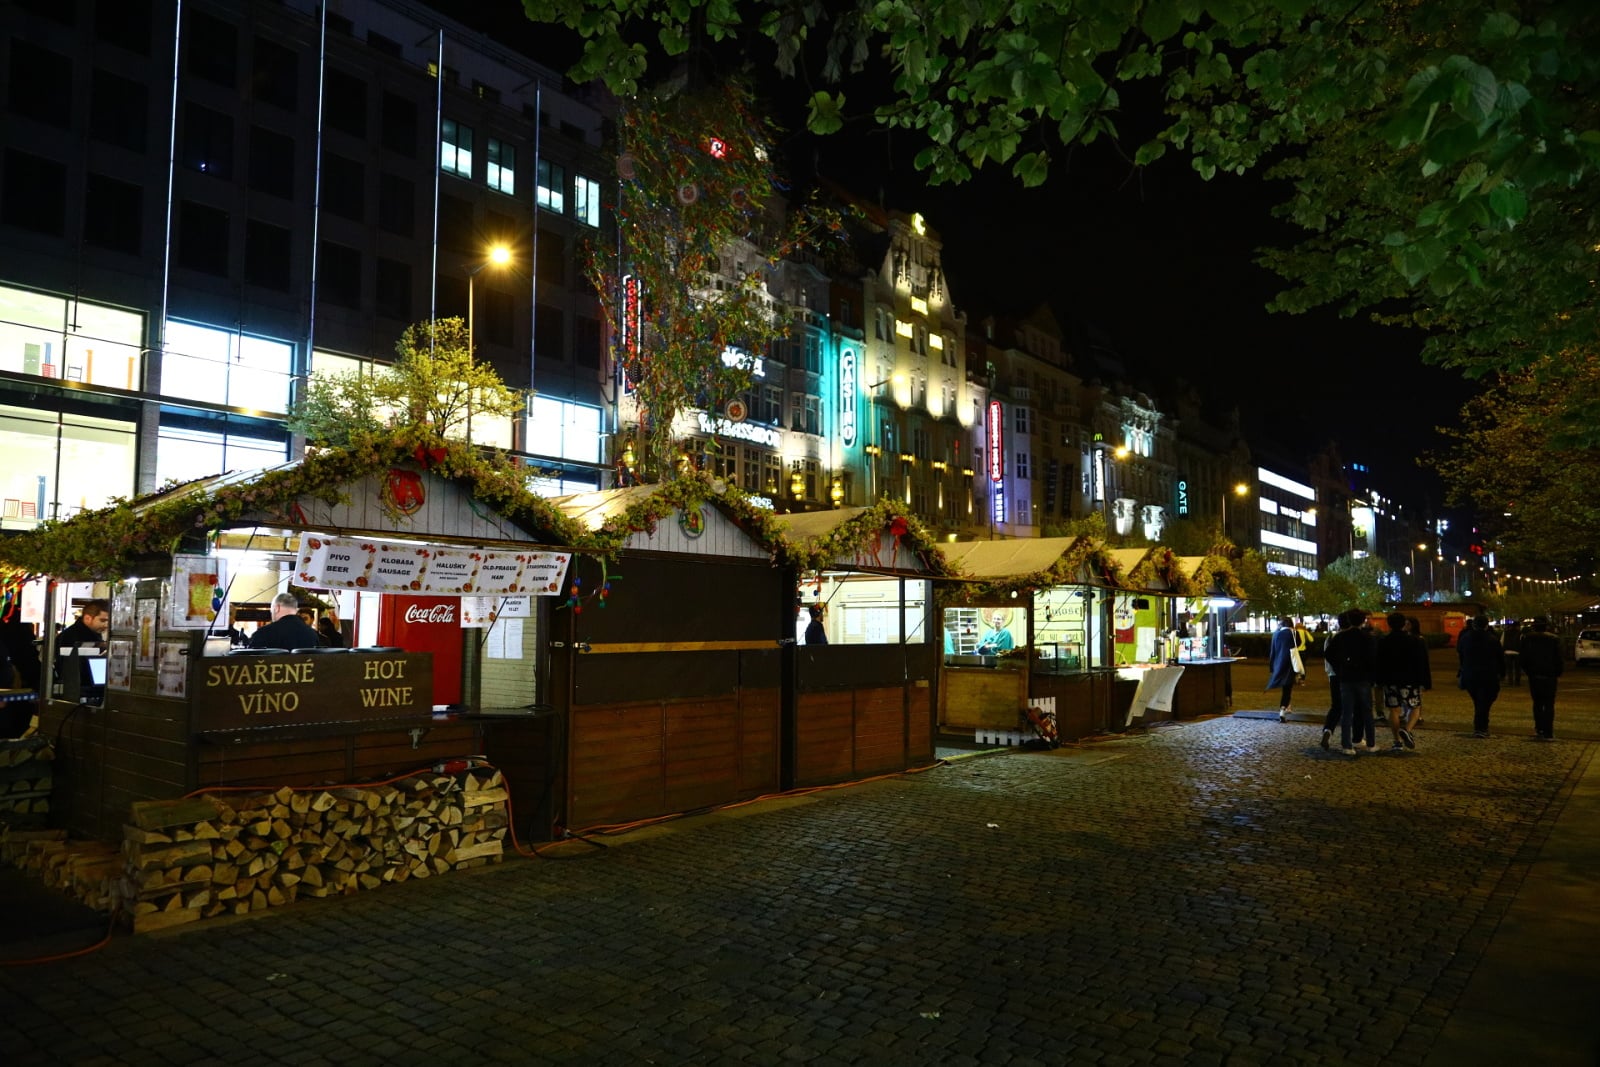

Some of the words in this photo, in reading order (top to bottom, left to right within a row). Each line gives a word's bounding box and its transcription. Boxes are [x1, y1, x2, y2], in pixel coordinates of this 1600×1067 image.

[843, 355, 854, 440] CASINO
[1178, 481, 1188, 514] GATE
[329, 553, 351, 561] PIVO
[326, 565, 349, 573] BEER
[377, 567, 411, 576] SAUSAGE
[405, 604, 455, 623] Coca-Cola
[206, 658, 315, 686] SVAŘENÉ
[363, 659, 407, 680] HOT
[238, 689, 299, 715] VÍNO
[360, 687, 414, 708] WINE
